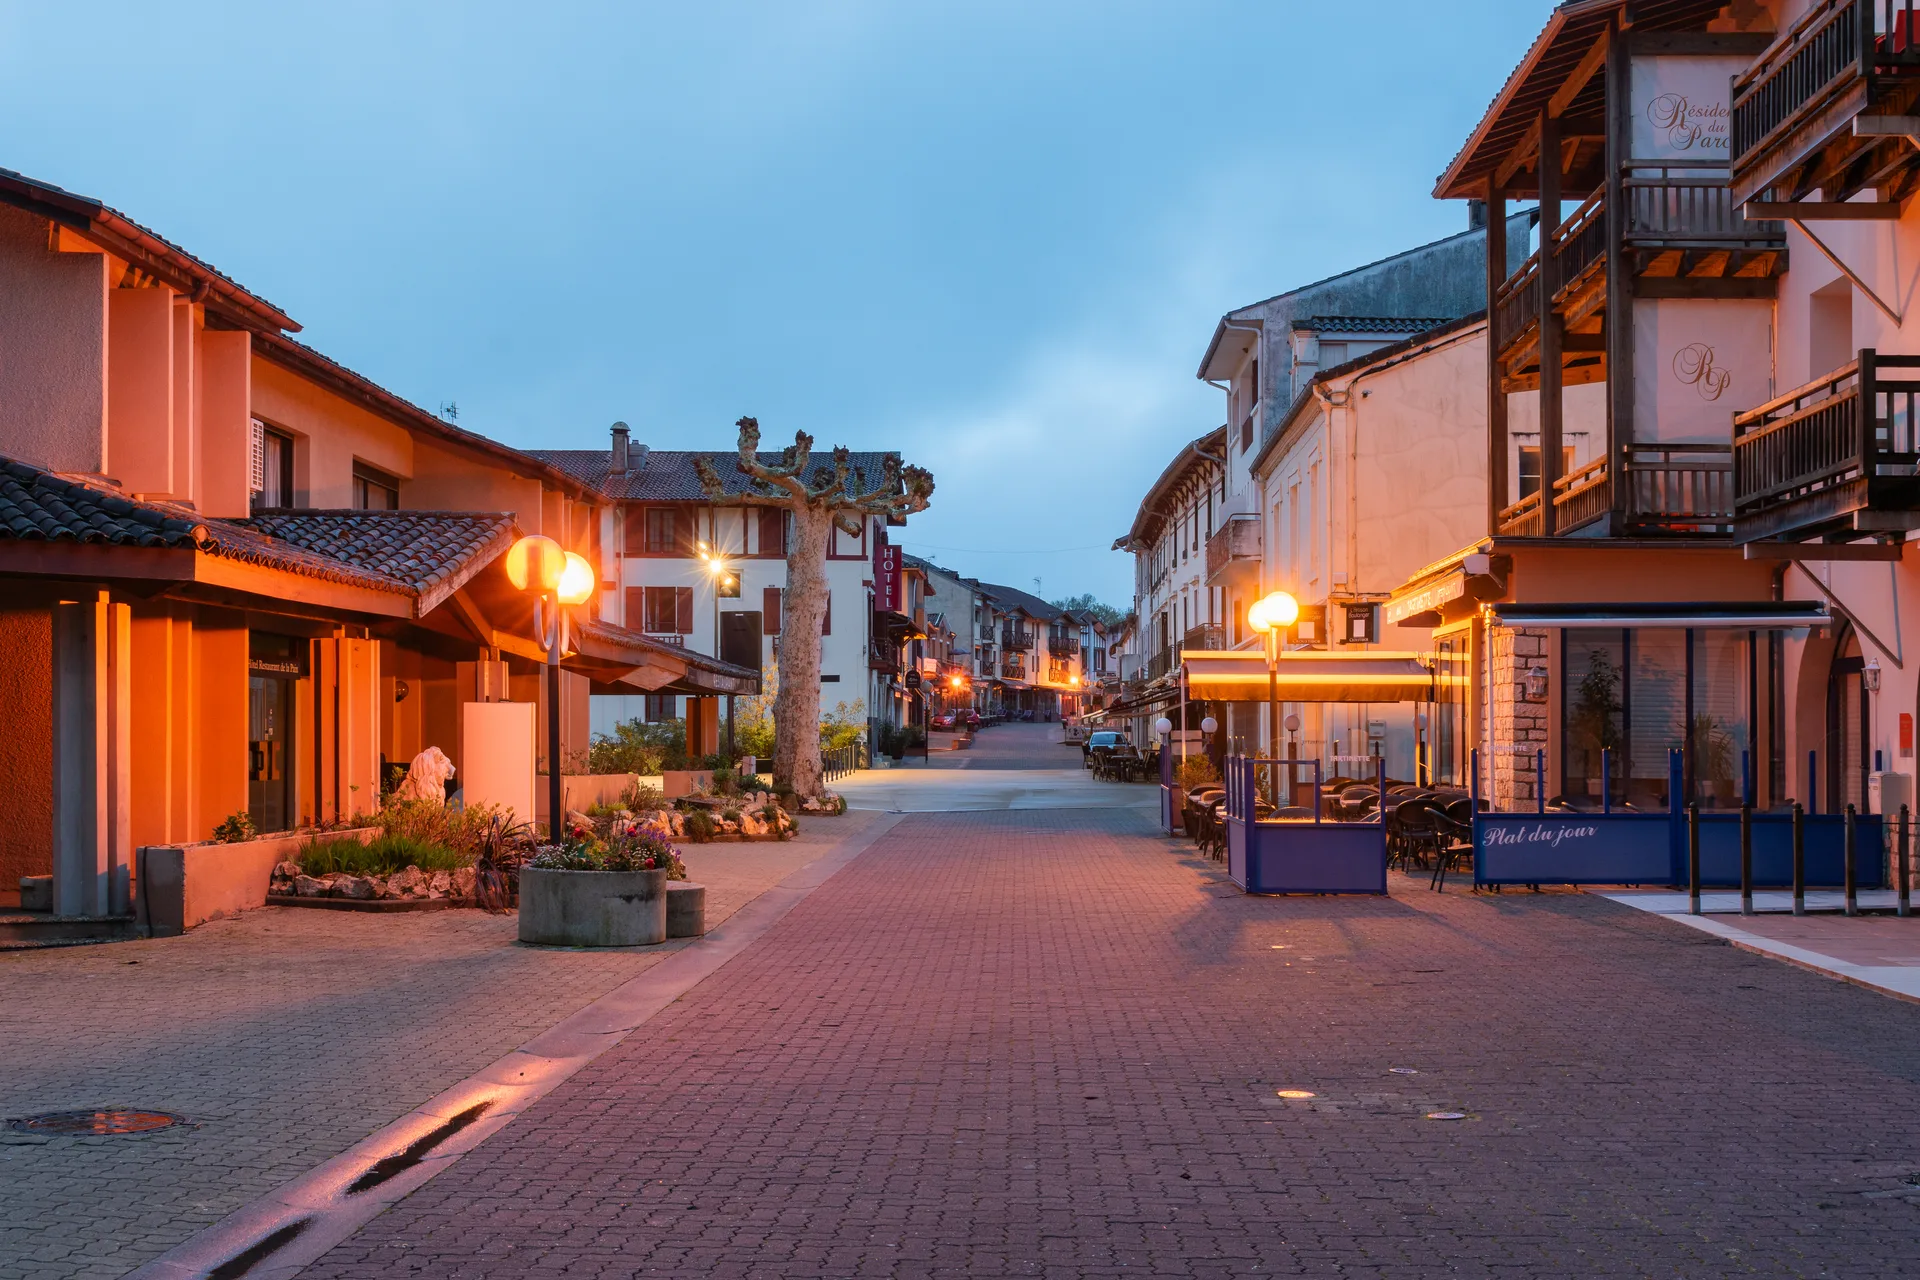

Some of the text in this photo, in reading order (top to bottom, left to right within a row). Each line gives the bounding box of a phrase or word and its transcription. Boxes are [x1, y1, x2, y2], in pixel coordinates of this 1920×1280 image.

[1708, 120, 1727, 133] du
[883, 548, 894, 608] HOTEL
[281, 662, 285, 671] de
[1482, 824, 1598, 848] Plat du jour
